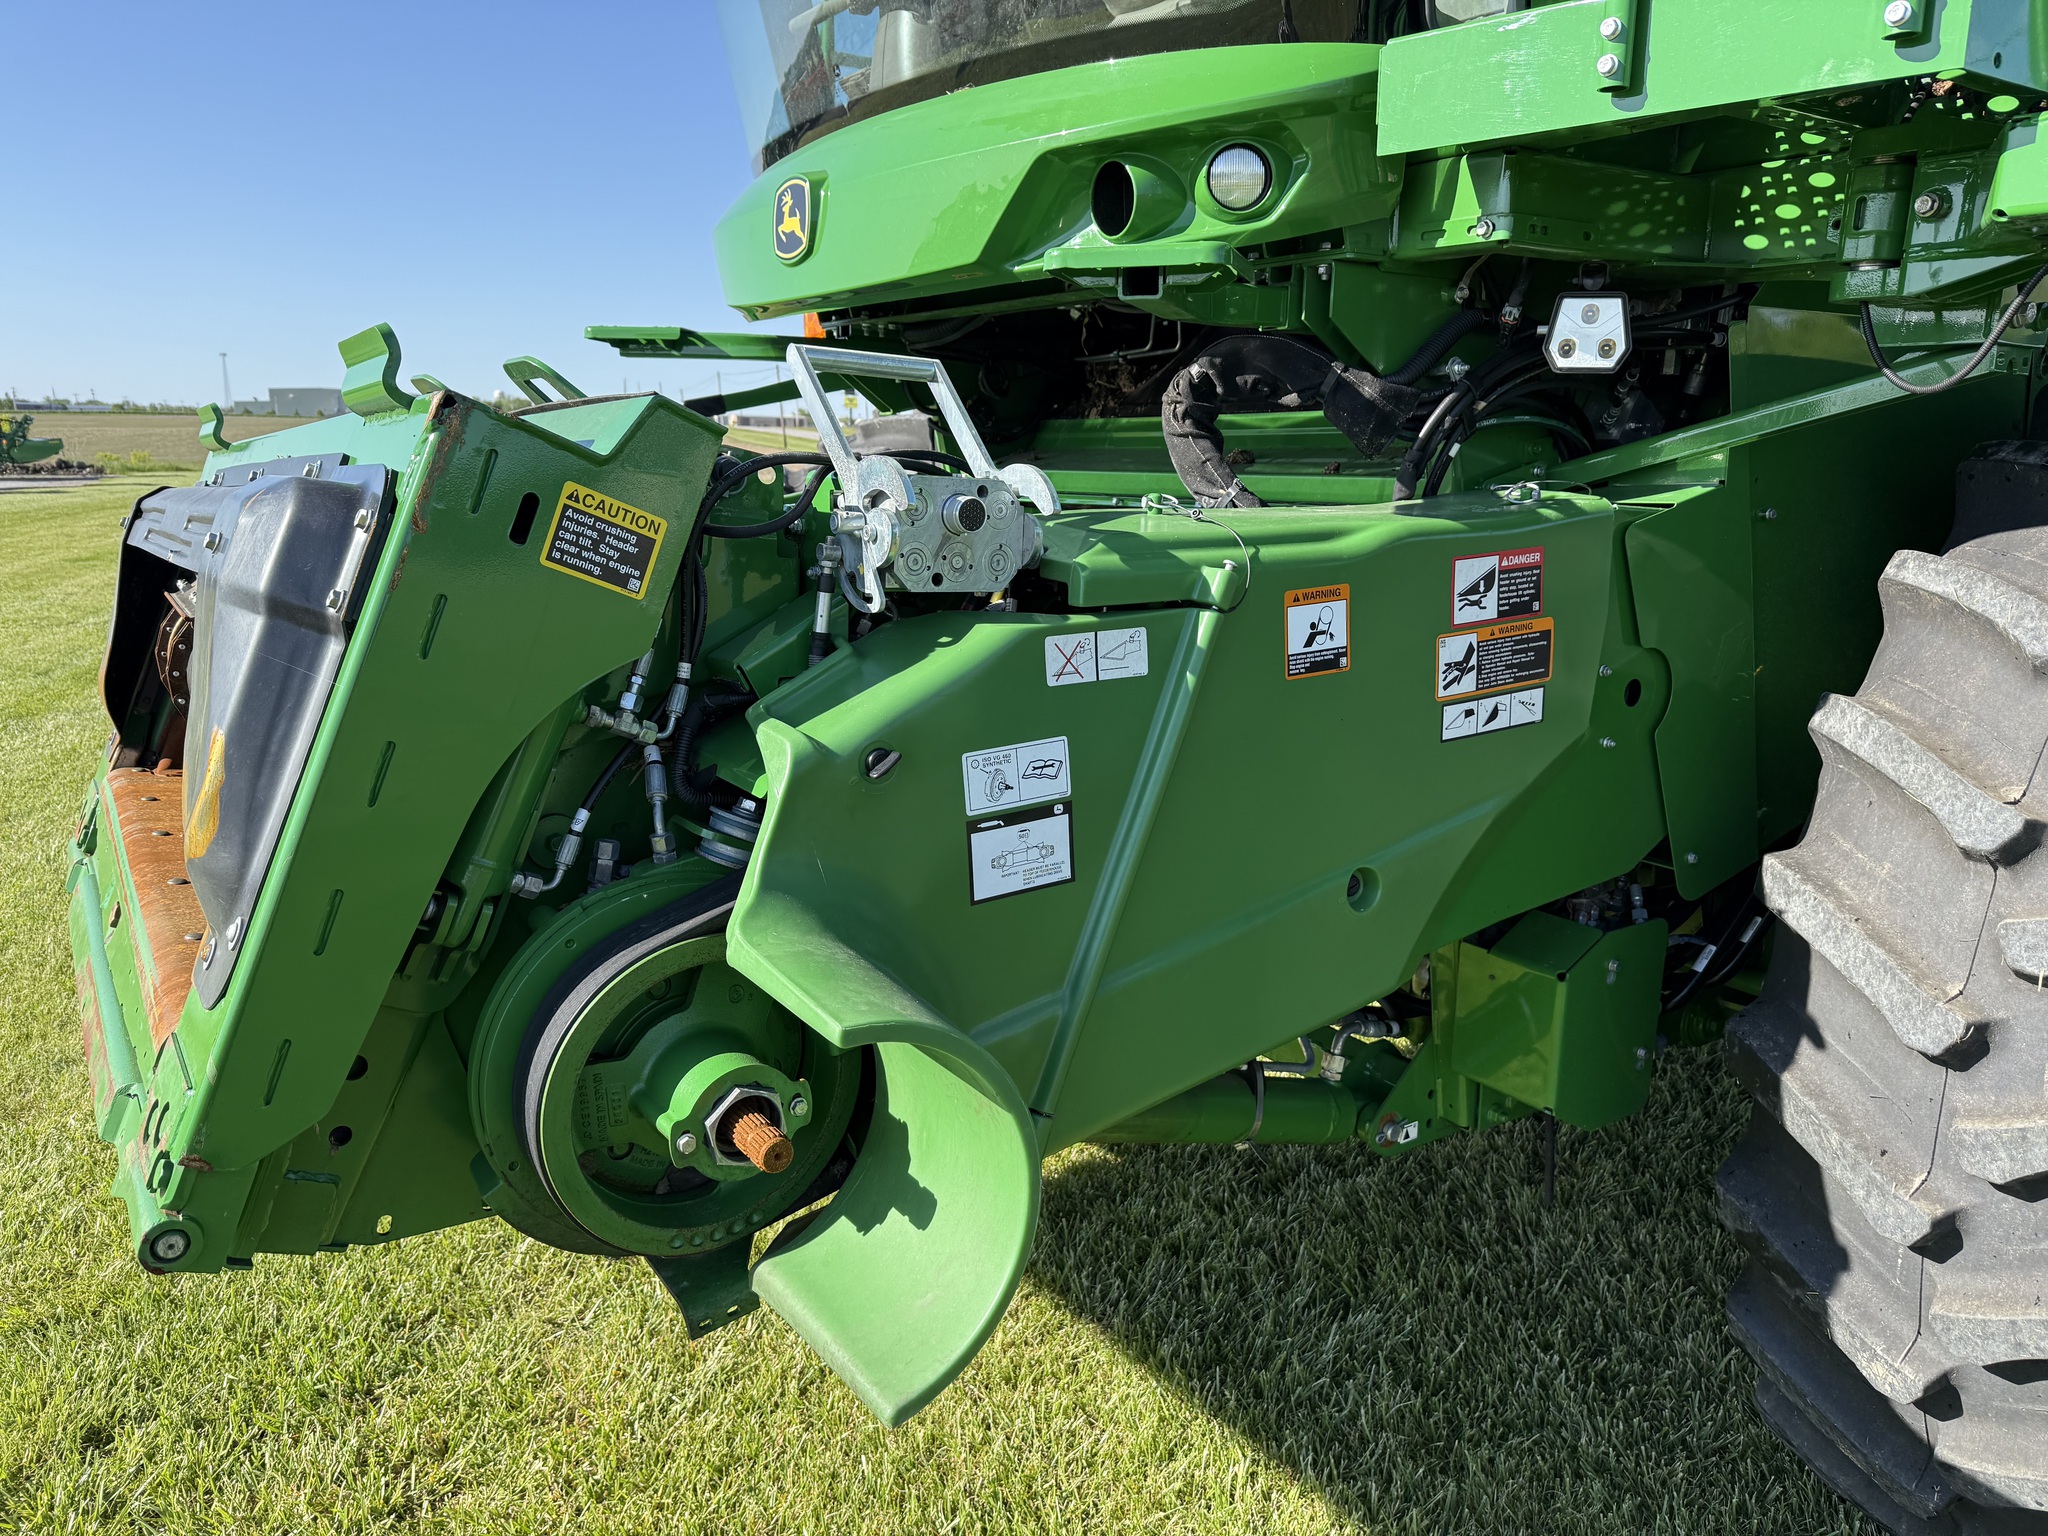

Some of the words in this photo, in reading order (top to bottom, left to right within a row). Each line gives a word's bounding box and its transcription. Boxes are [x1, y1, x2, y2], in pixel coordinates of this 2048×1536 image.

[565, 509, 594, 525] Avoid
[596, 522, 637, 544] crushing
[582, 494, 661, 535] CAUTION
[559, 530, 576, 542] can
[579, 537, 593, 548] tilt.
[599, 544, 620, 559] Stay
[562, 518, 600, 539] injuries.
[605, 535, 639, 554] Header
[552, 549, 561, 558] is
[563, 555, 602, 575] running.
[555, 540, 579, 554] clear
[582, 549, 607, 564] when
[609, 561, 640, 577] engine
[1509, 553, 1540, 565] DANGER
[1302, 588, 1341, 601] WARNING
[1498, 623, 1533, 634] WARNING
[982, 759, 1012, 768] SYNTHETIC
[592, 1072, 604, 1102] SPAIN
[597, 1115, 608, 1142] MADE
